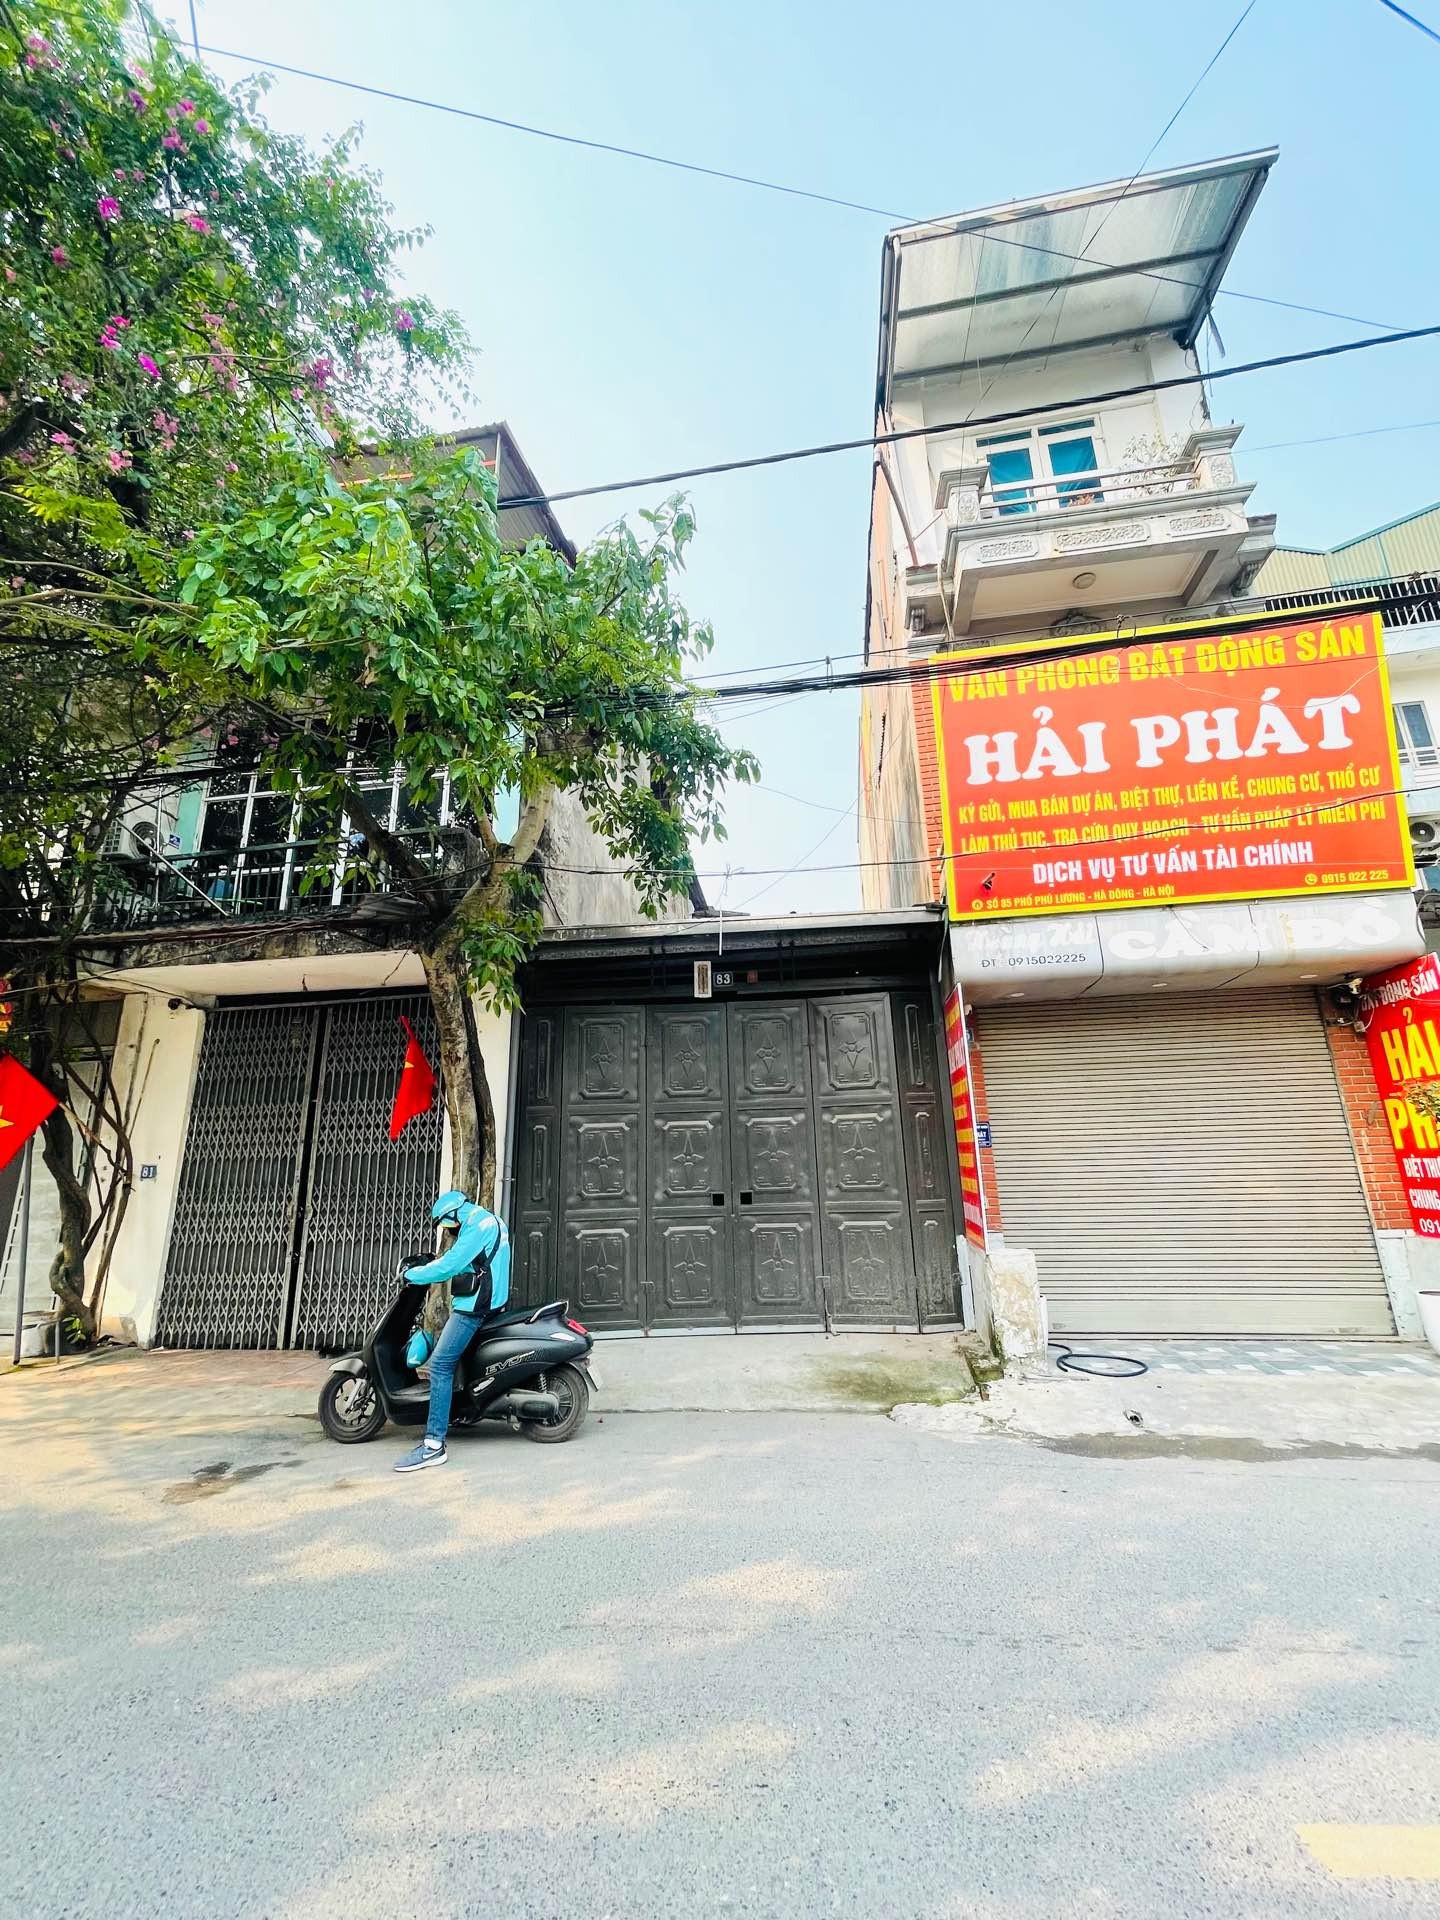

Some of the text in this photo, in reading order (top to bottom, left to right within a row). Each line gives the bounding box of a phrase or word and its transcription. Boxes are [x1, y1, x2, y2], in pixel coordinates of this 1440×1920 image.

[142, 167, 154, 177] 81
[1195, 636, 1286, 677] ĐỘNG
[1296, 621, 1366, 661] SẢN
[963, 687, 1361, 785] HẢI PHÁT
[959, 801, 975, 825] KÝ
[979, 798, 1006, 823] GỬI,
[1008, 800, 1038, 819] MUA
[1041, 794, 1069, 816] BÁN
[1073, 792, 1091, 816] DỰ
[1094, 790, 1118, 812] ÁN,
[1120, 786, 1150, 811] BIỆT
[1153, 783, 1184, 808] THỰ,
[1247, 775, 1297, 797] CHUNG
[1299, 771, 1324, 792] CƯ,
[1327, 763, 1356, 789] THỔ
[1359, 766, 1380, 786] CƯ
[961, 833, 990, 854] LÀM
[992, 827, 1018, 851] THỦ
[1053, 828, 1078, 846] TRA
[1112, 821, 1138, 843] QUY
[1143, 817, 1189, 841] HOẠCH
[1201, 813, 1220, 834] TƯ
[1222, 806, 1252, 832] VẤN
[1254, 805, 1292, 830] PHÁP
[1359, 796, 1386, 822] PHÍ
[1033, 839, 1314, 887] DỊCH VỤ TƯ VẤN TÀI CHÍNH
[1321, 869, 1389, 883] 0915 022 225
[716, 973, 731, 985] 83
[1008, 953, 1086, 967] 0915022225
[1411, 966, 1439, 996] SẢN
[1381, 1007, 1440, 1080] HẢI
